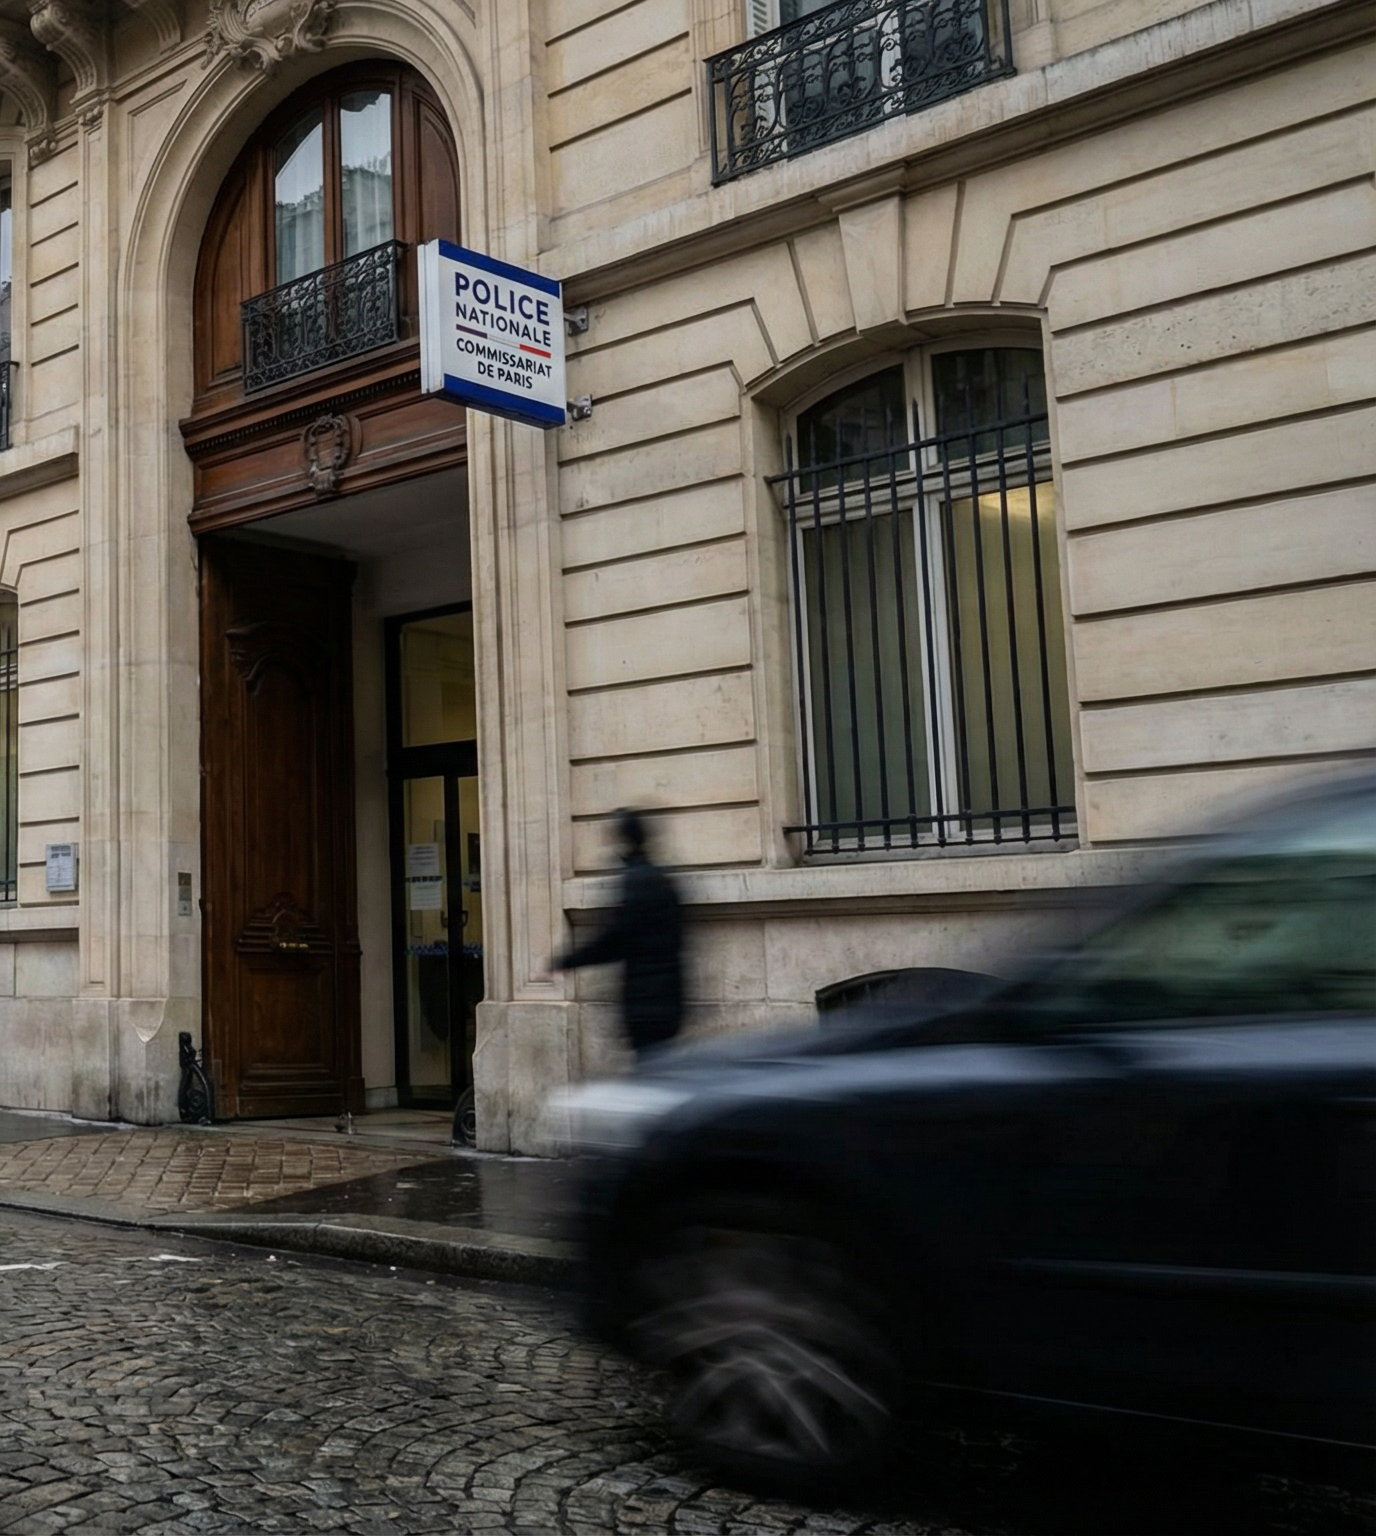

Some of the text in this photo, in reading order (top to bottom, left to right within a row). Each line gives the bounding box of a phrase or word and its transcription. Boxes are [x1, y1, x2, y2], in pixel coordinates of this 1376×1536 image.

[455, 272, 550, 326] POLICE
[456, 302, 551, 347] NATIONALE
[457, 338, 552, 378] COMMISSARIAT
[478, 361, 532, 389] DE PARIS
